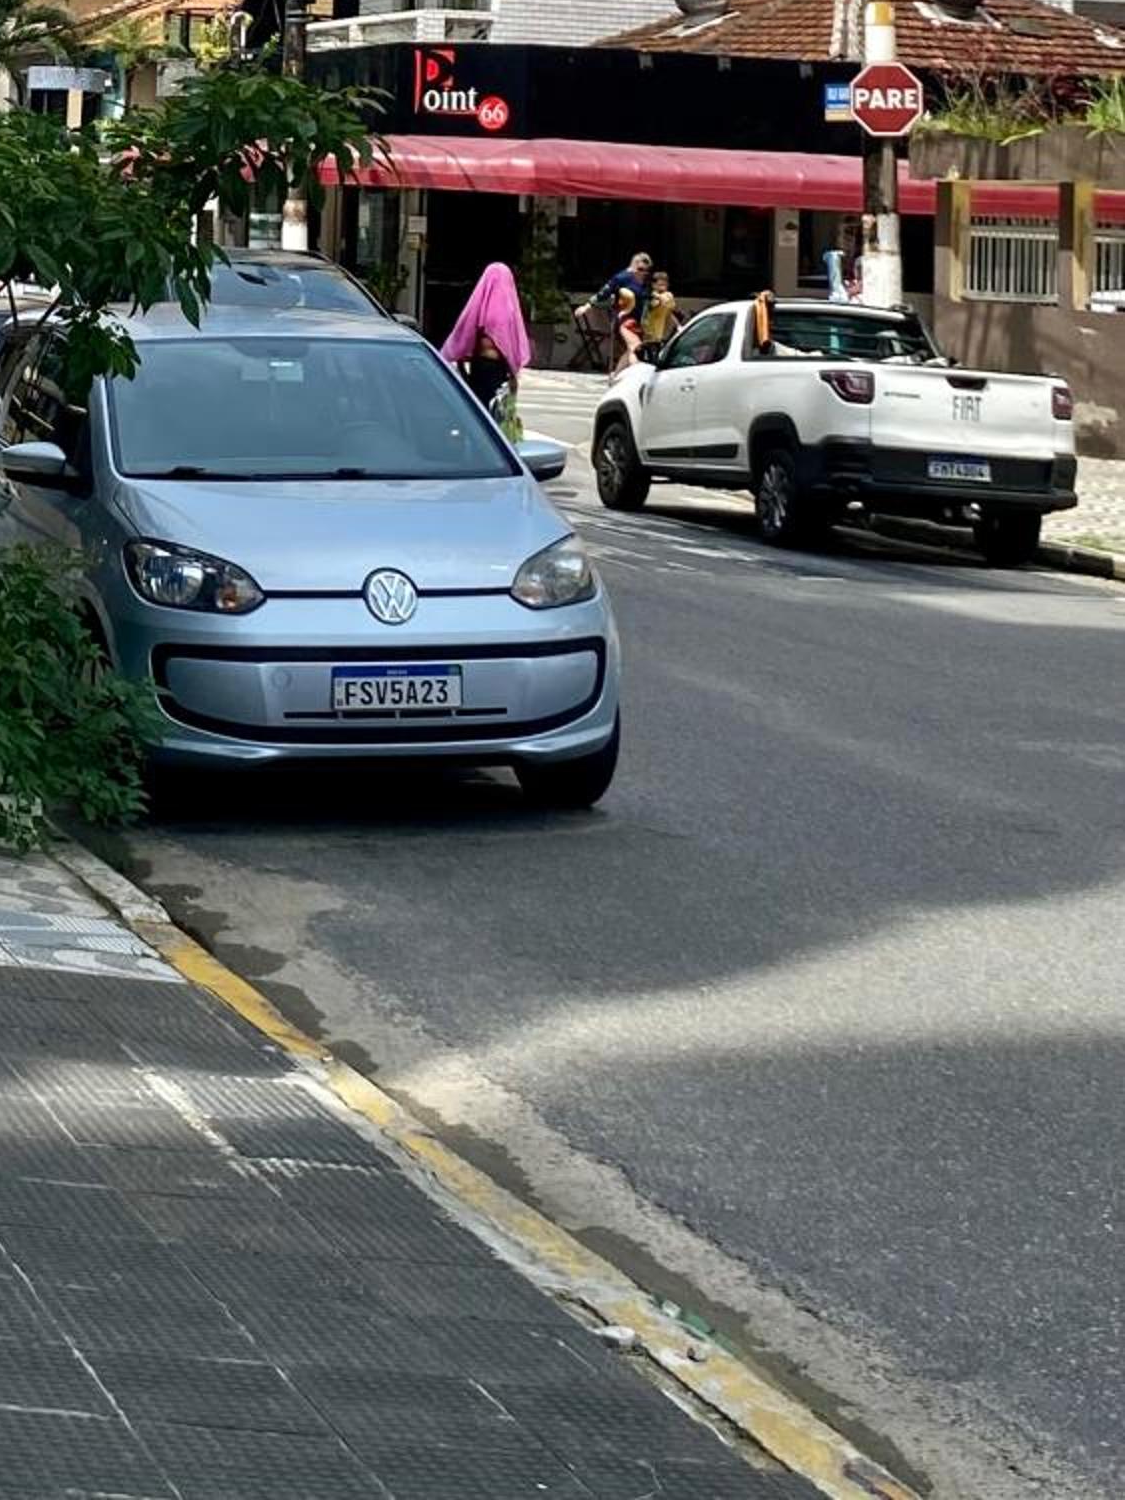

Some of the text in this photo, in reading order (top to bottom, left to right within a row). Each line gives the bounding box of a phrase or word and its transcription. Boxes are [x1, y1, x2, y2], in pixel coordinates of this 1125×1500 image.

[415, 49, 504, 122] Point 66
[855, 88, 918, 110] PARE
[952, 395, 982, 422] FIAT
[344, 679, 449, 706] FSV5A23
